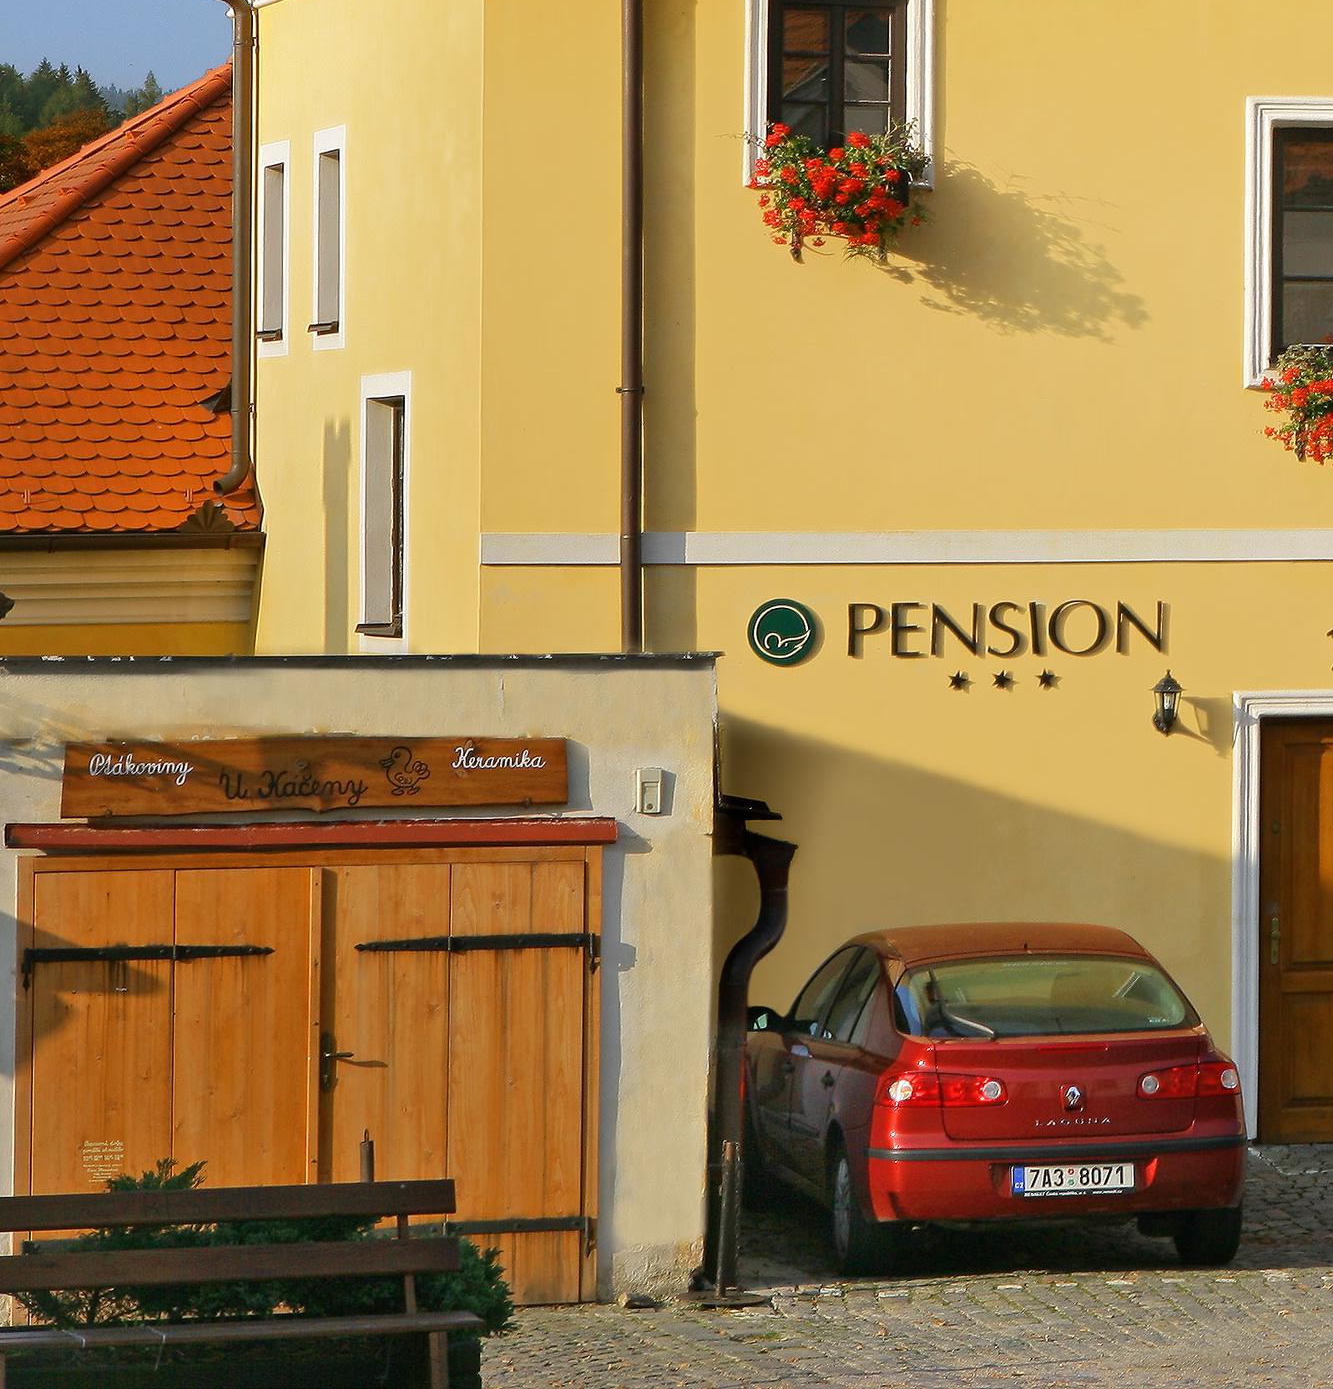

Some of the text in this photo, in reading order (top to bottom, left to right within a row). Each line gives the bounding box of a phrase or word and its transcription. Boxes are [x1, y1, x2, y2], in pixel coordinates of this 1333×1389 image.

[847, 599, 1164, 659] PENSION
[89, 753, 194, 785] Ptákoviny
[452, 746, 546, 769] Keramika
[219, 761, 369, 805] U Káčeny
[1029, 1168, 1065, 1189] 7A3
[1079, 1166, 1125, 1186] 8071
